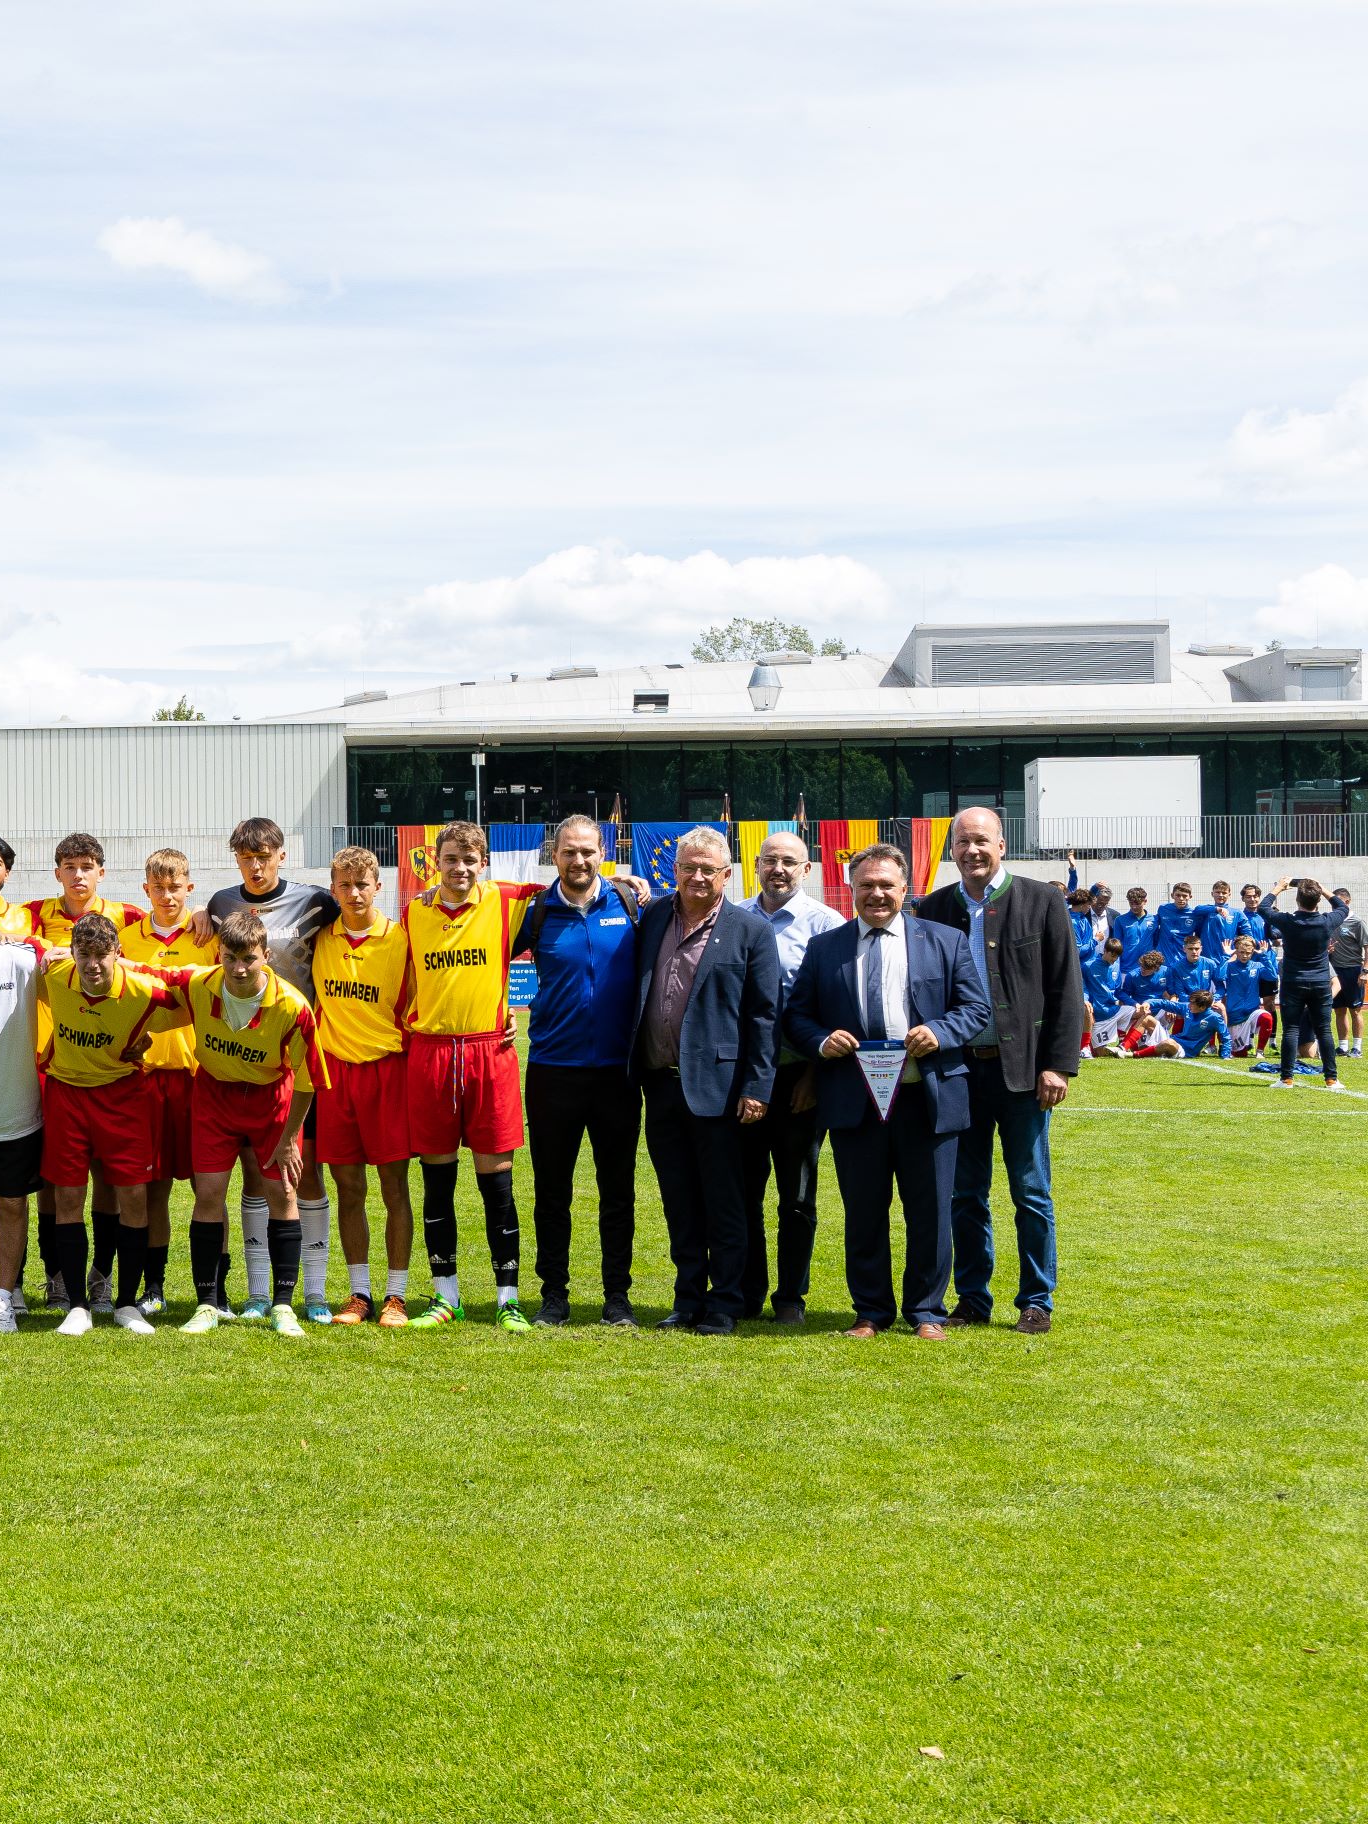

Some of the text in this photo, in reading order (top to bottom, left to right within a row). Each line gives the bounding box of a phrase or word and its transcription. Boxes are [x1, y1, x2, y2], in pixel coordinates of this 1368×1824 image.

[424, 948, 487, 971] SCHWABEN
[324, 979, 380, 1004] SCHWABEN
[58, 1023, 114, 1049] SCHWABEN
[204, 1033, 268, 1063] SCHWABEN
[1096, 1031, 1109, 1044] 13
